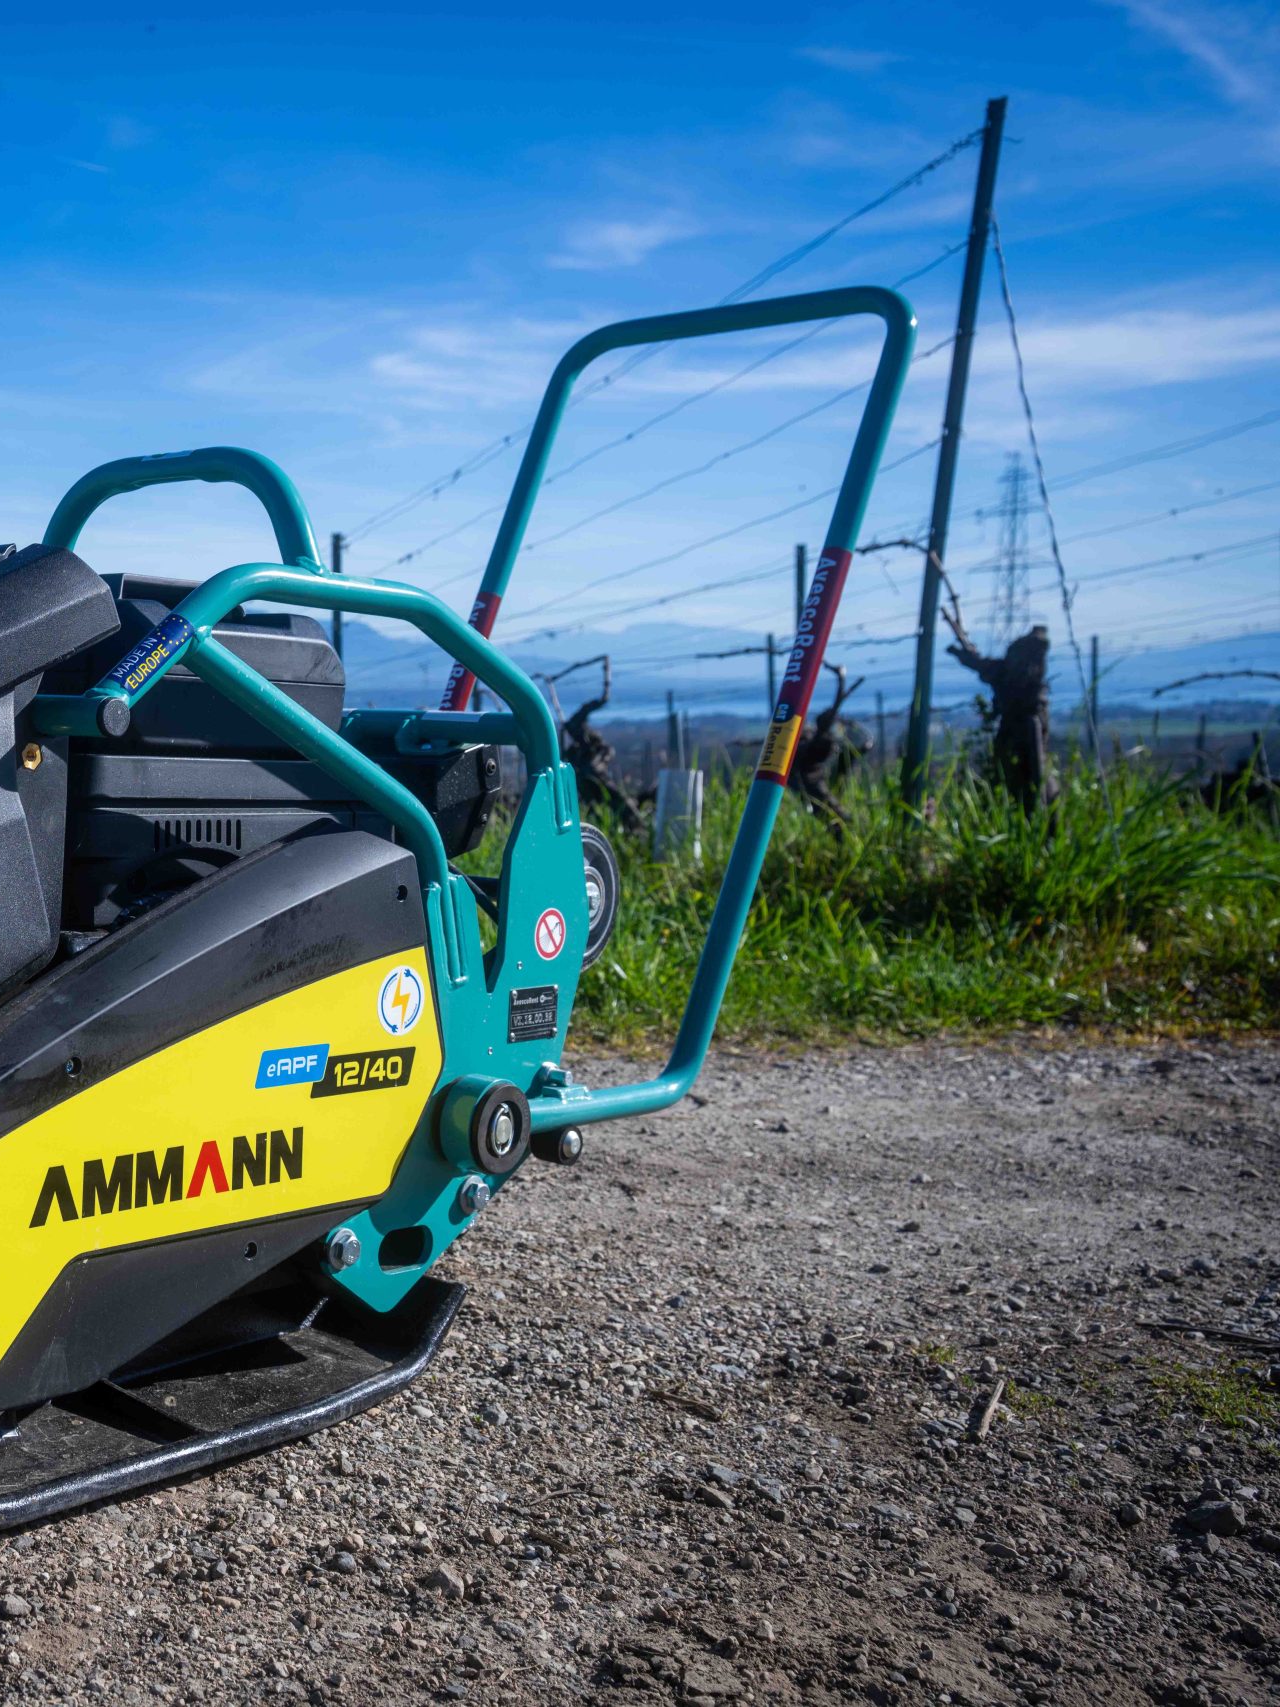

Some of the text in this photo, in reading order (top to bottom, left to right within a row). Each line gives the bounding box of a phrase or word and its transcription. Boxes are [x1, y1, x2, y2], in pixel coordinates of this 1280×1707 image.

[783, 556, 837, 683] AvescoRent
[112, 637, 158, 678] MADE IN
[126, 643, 170, 690] EUROPE
[775, 703, 789, 720] CAT
[761, 725, 782, 767] Rental
[266, 1054, 403, 1088] eAPF 12/40
[28, 1126, 304, 1229] AMMANN
